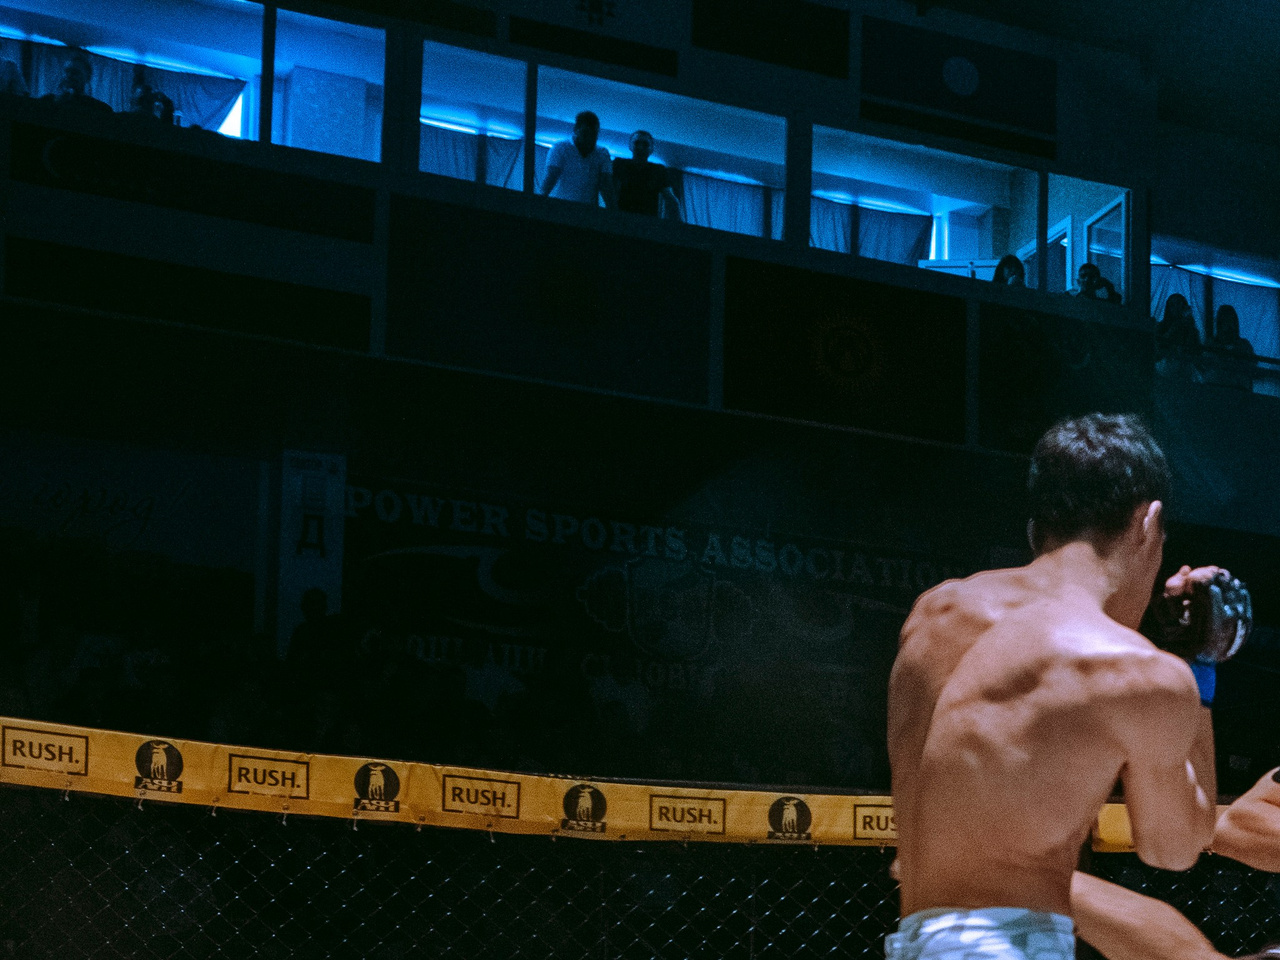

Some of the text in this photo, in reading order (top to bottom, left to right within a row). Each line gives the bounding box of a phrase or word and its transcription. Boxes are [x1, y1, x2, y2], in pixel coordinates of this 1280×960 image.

[344, 485, 955, 590] POWER SPORTS ASSOCIATIO
[12, 739, 80, 764] RUSH.
[237, 766, 301, 789] RUSH.
[451, 786, 512, 808] RUSH.
[658, 806, 718, 825] RUSH.
[862, 814, 898, 831] RUS
